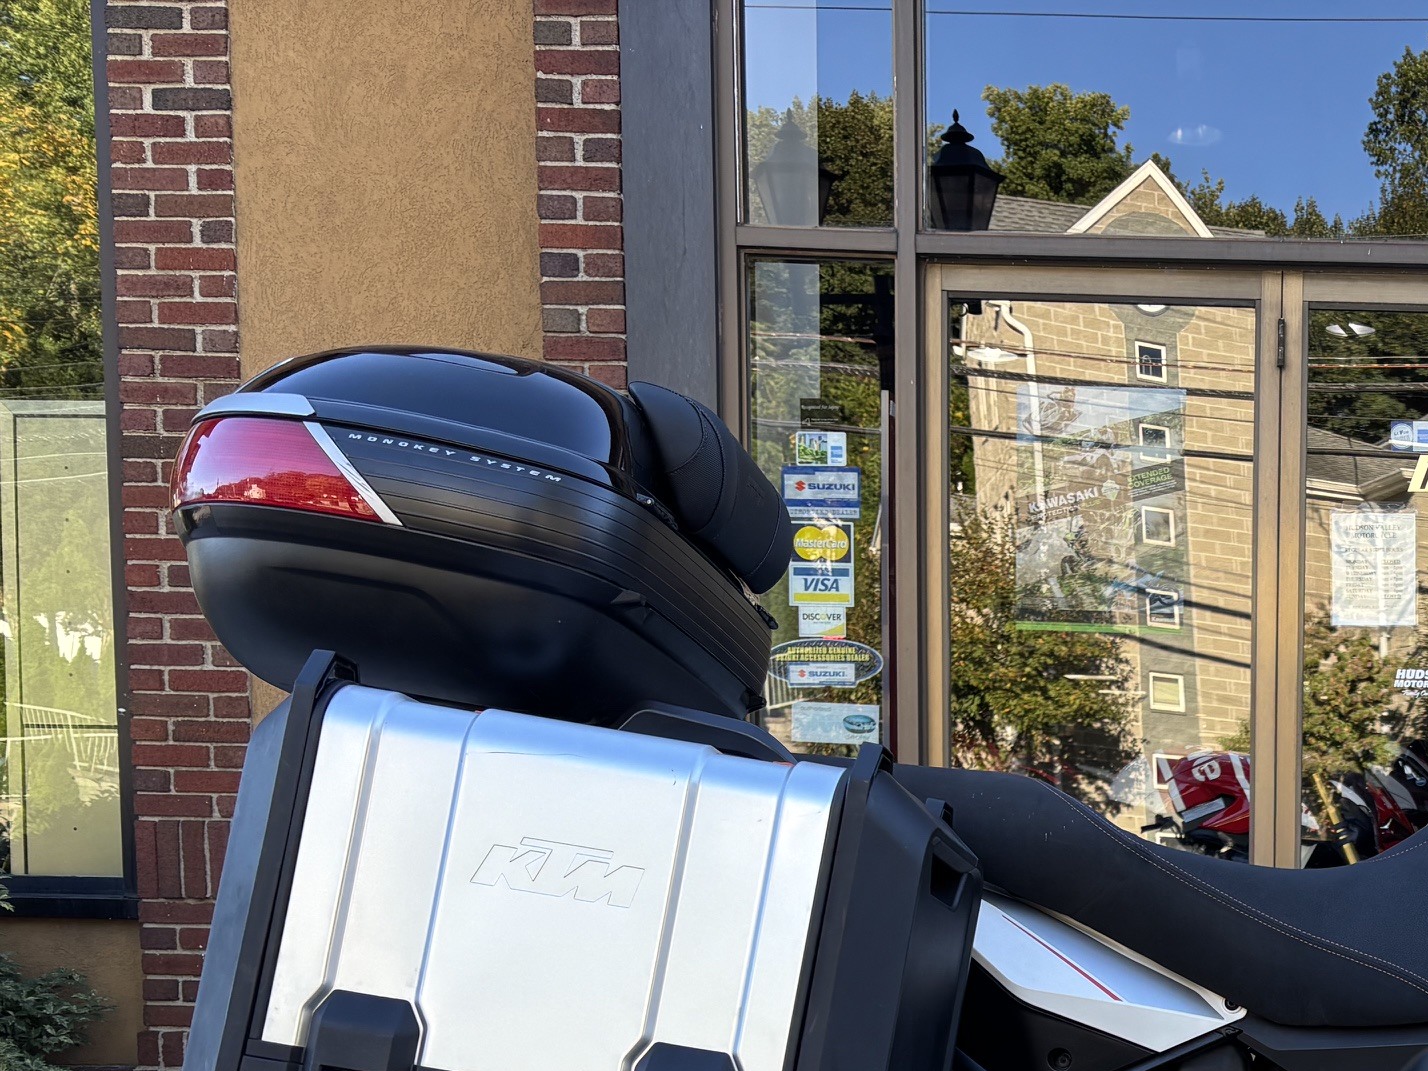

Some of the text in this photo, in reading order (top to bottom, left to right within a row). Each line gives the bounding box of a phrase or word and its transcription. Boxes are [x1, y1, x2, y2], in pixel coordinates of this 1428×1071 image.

[348, 432, 563, 484] MONOKEY SYSTEM
[1128, 467, 1170, 483] EXTENDED
[1128, 473, 1173, 489] COVERAGE
[808, 482, 855, 491] SUZUKI
[1028, 487, 1099, 514] KAWASAKI
[795, 538, 847, 548] MasterCard
[803, 578, 840, 592] VISA
[802, 613, 841, 621] DISCOVER
[470, 835, 646, 909] KTM
